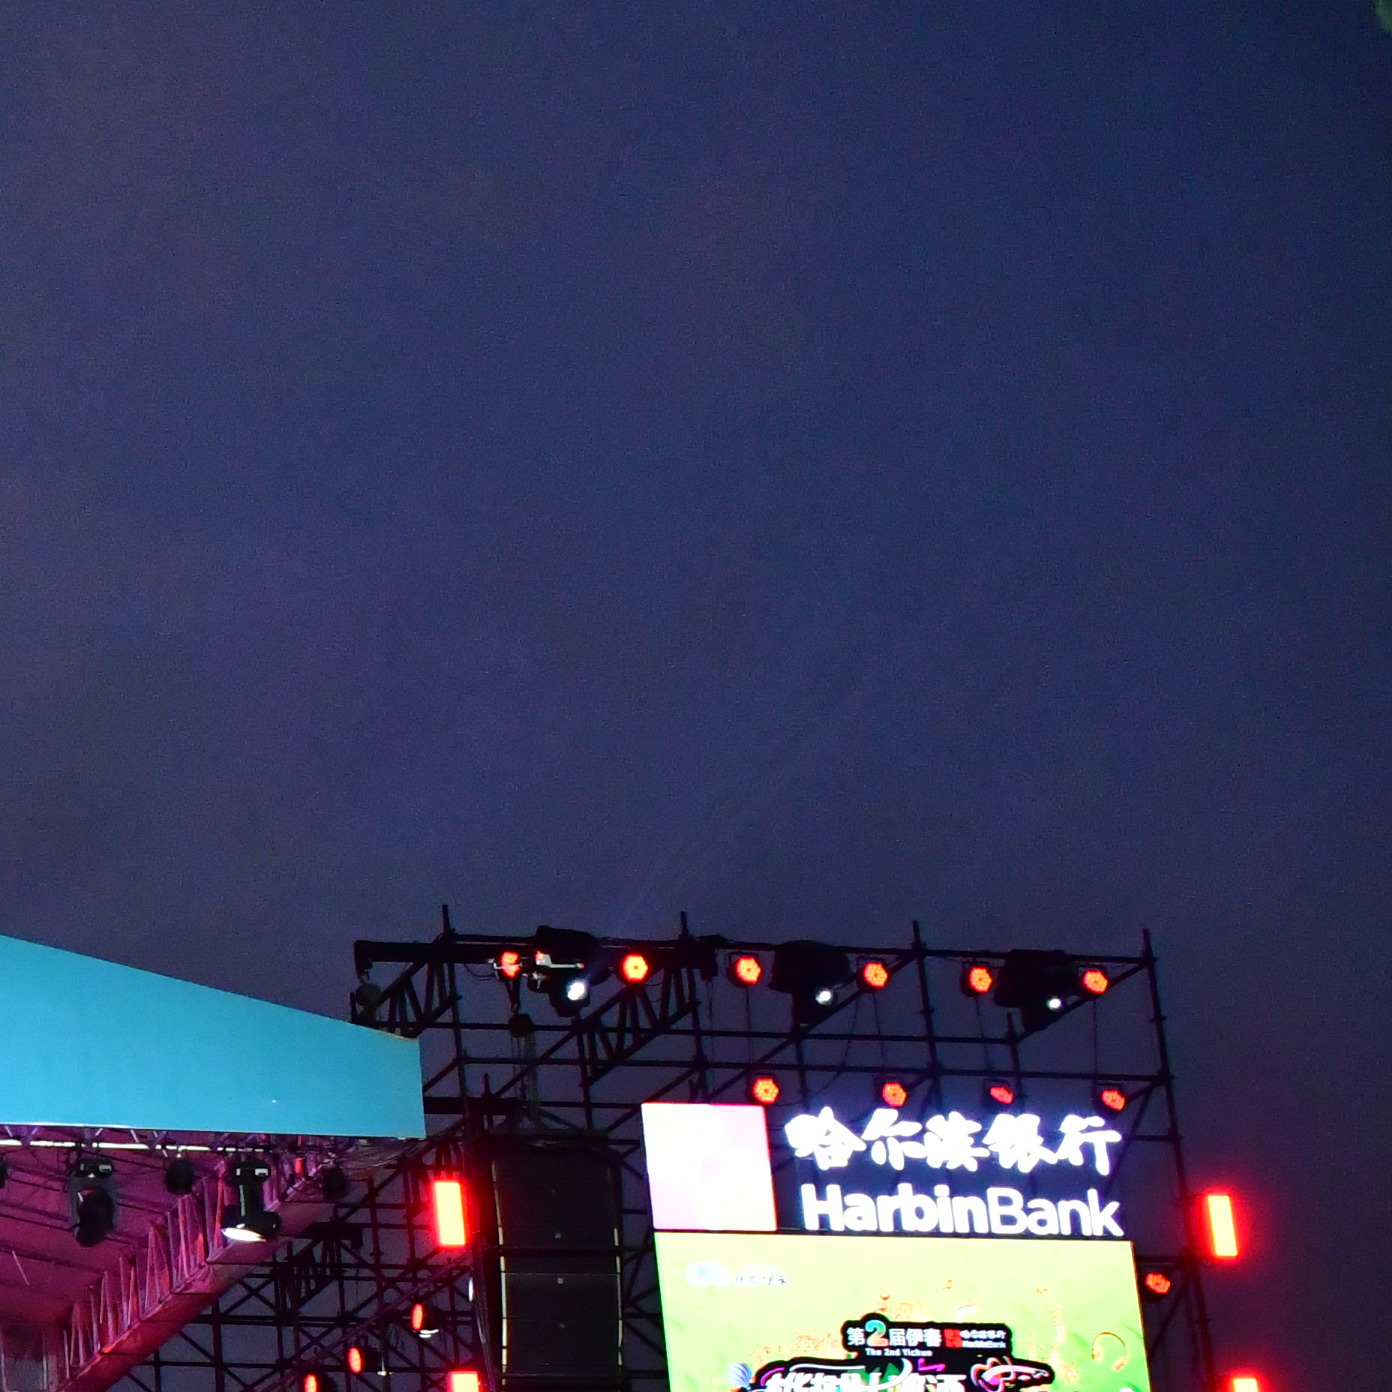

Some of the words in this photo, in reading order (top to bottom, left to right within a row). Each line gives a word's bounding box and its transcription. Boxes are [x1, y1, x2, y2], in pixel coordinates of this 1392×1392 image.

[785, 1107, 1122, 1175] 哈尔滨银行
[801, 1183, 1123, 1237] HarbinBank
